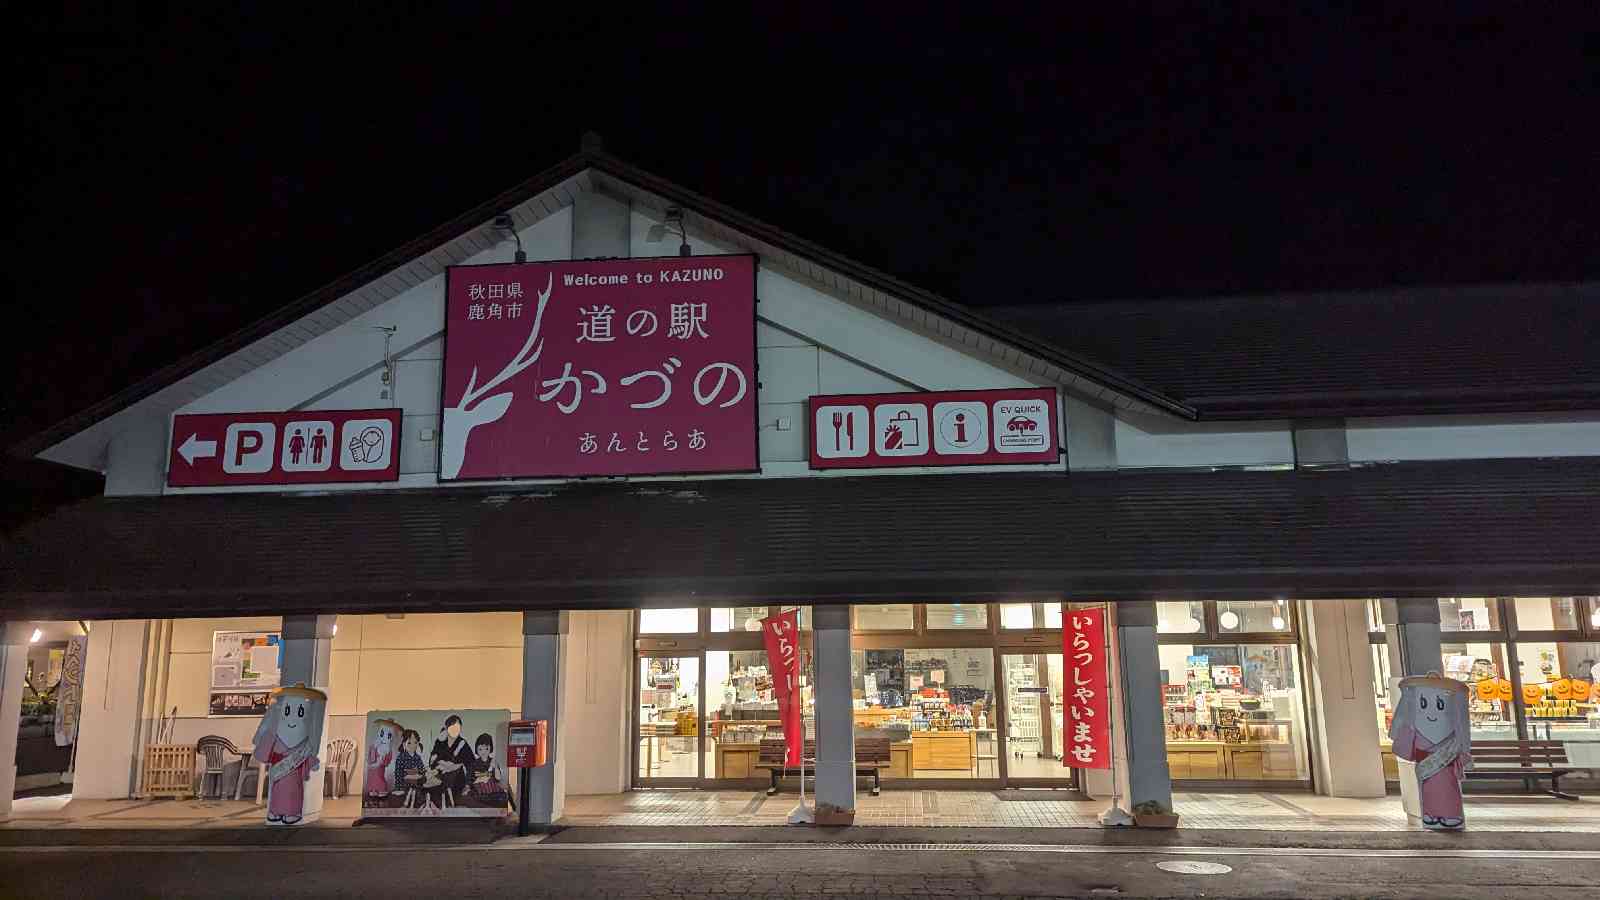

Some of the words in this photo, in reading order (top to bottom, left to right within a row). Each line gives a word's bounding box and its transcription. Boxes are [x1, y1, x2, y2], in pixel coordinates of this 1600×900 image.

[563, 273, 629, 286] Welcome
[636, 272, 653, 284] to
[660, 269, 724, 283] KAZUNO
[468, 282, 524, 300] 秋田県
[468, 302, 524, 320] 鹿角市
[576, 302, 710, 344] 道の駅
[539, 356, 747, 414] かづの
[1015, 406, 1041, 414] QUICK
[235, 430, 264, 466] P
[579, 428, 707, 453] あんとらあ
